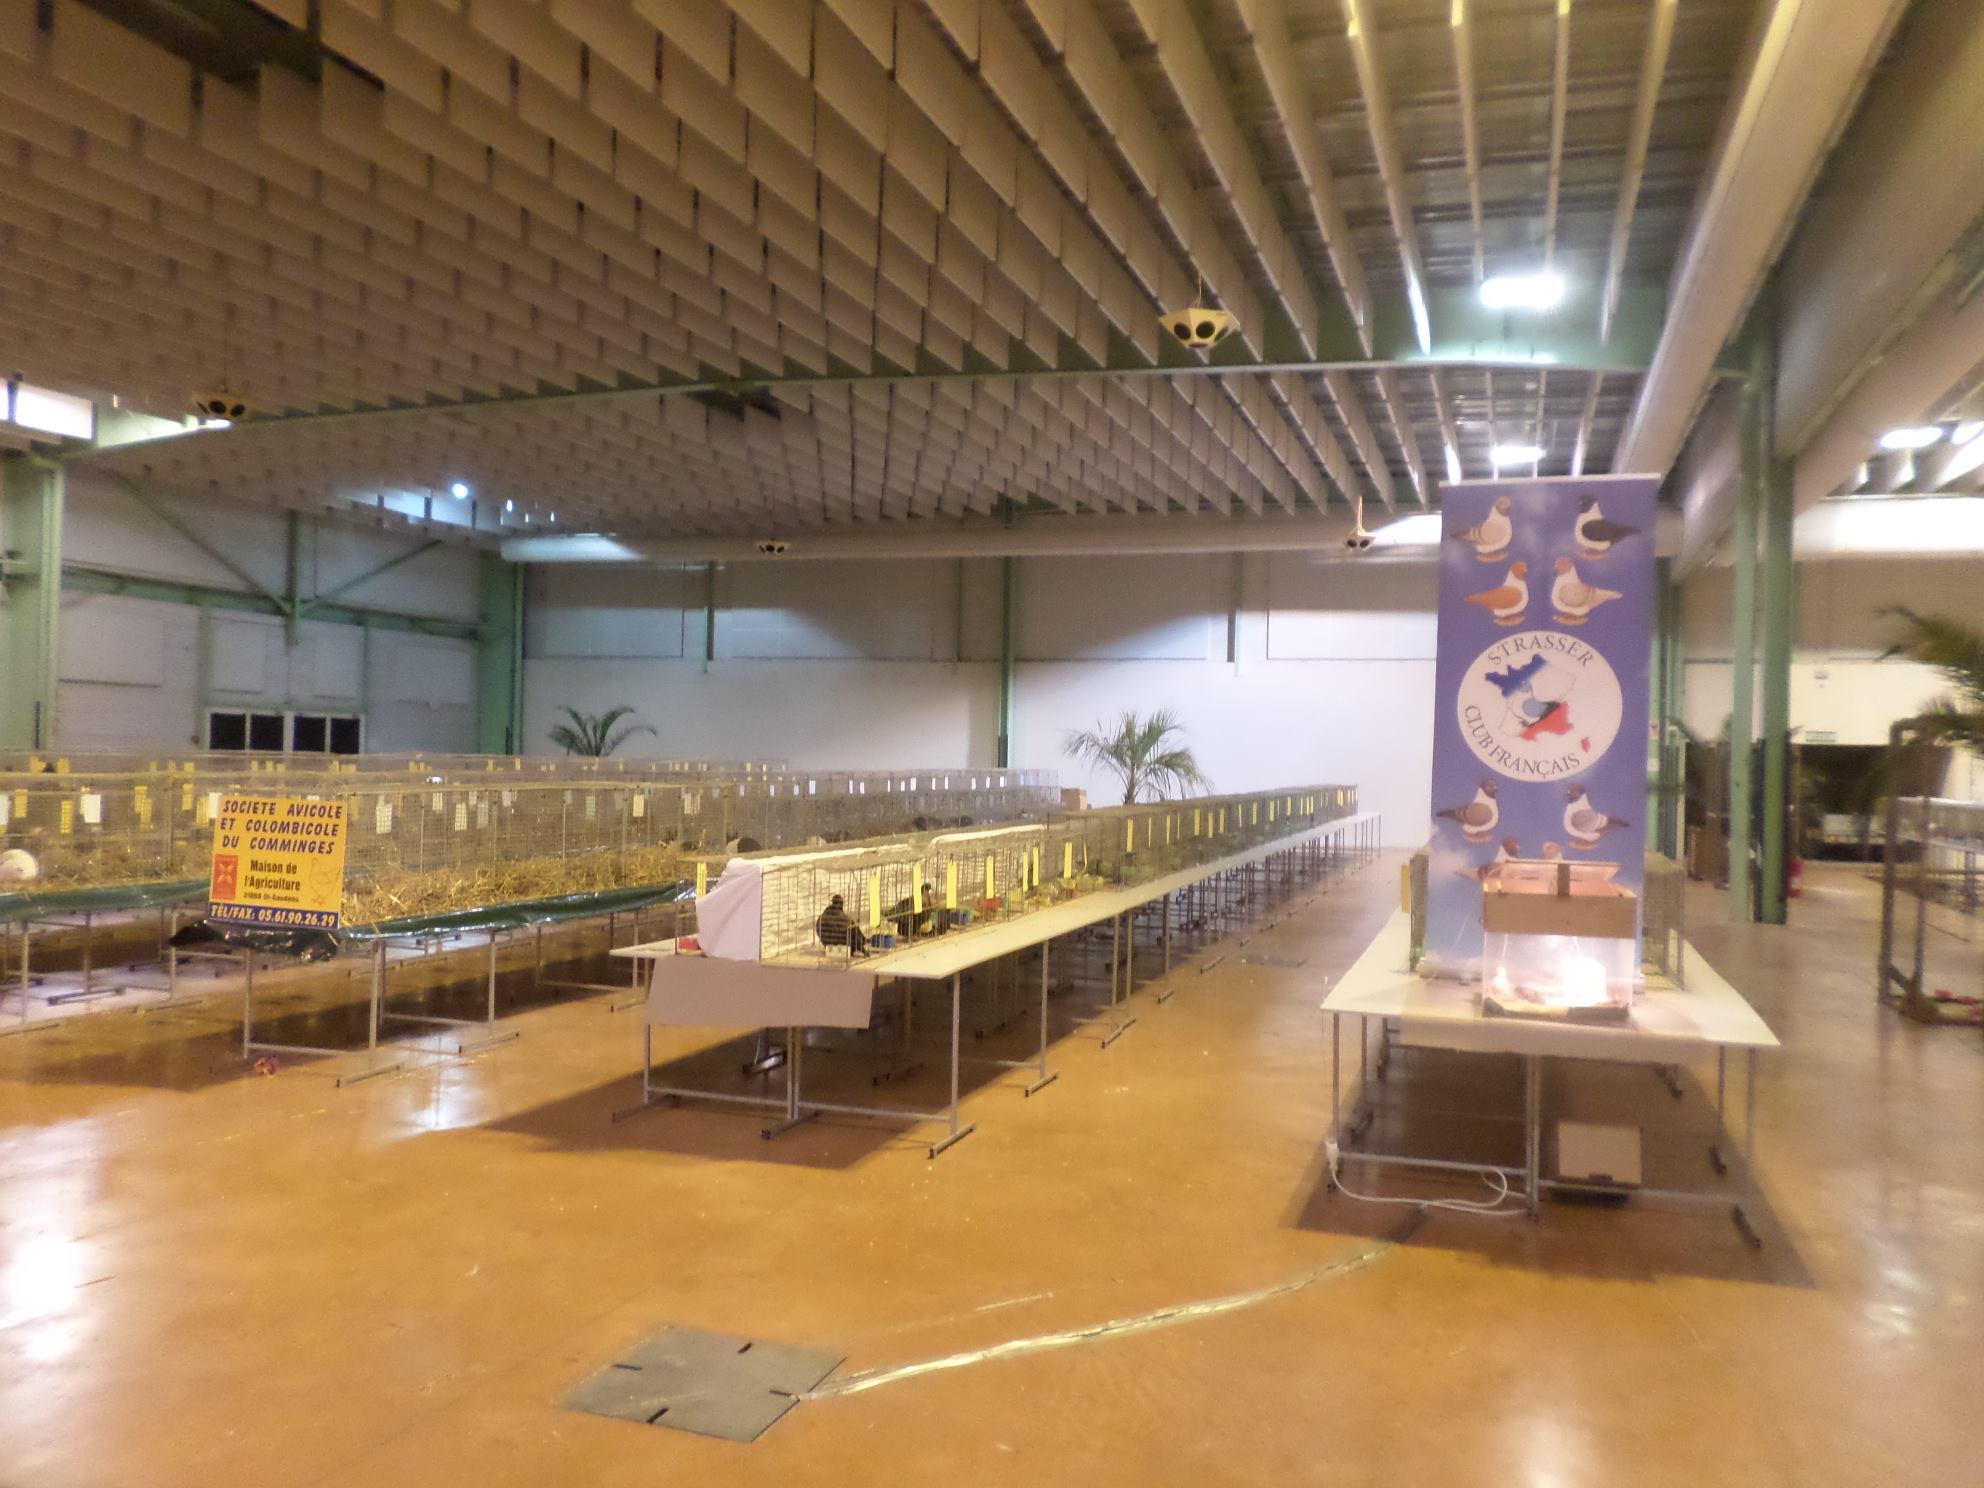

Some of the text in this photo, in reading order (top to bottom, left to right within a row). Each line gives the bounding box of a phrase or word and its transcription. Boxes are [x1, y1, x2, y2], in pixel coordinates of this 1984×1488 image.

[1488, 635, 1594, 667] STRASSER
[1464, 705, 1581, 778] CLUB FRANÇAIS
[223, 799, 343, 819] SOCIETE AVICOLE
[220, 817, 339, 837] ET COLOMBICOLE
[222, 835, 335, 854] DU COMMINGES
[250, 859, 297, 874] Maison de
[244, 875, 301, 891] l'Agriculture
